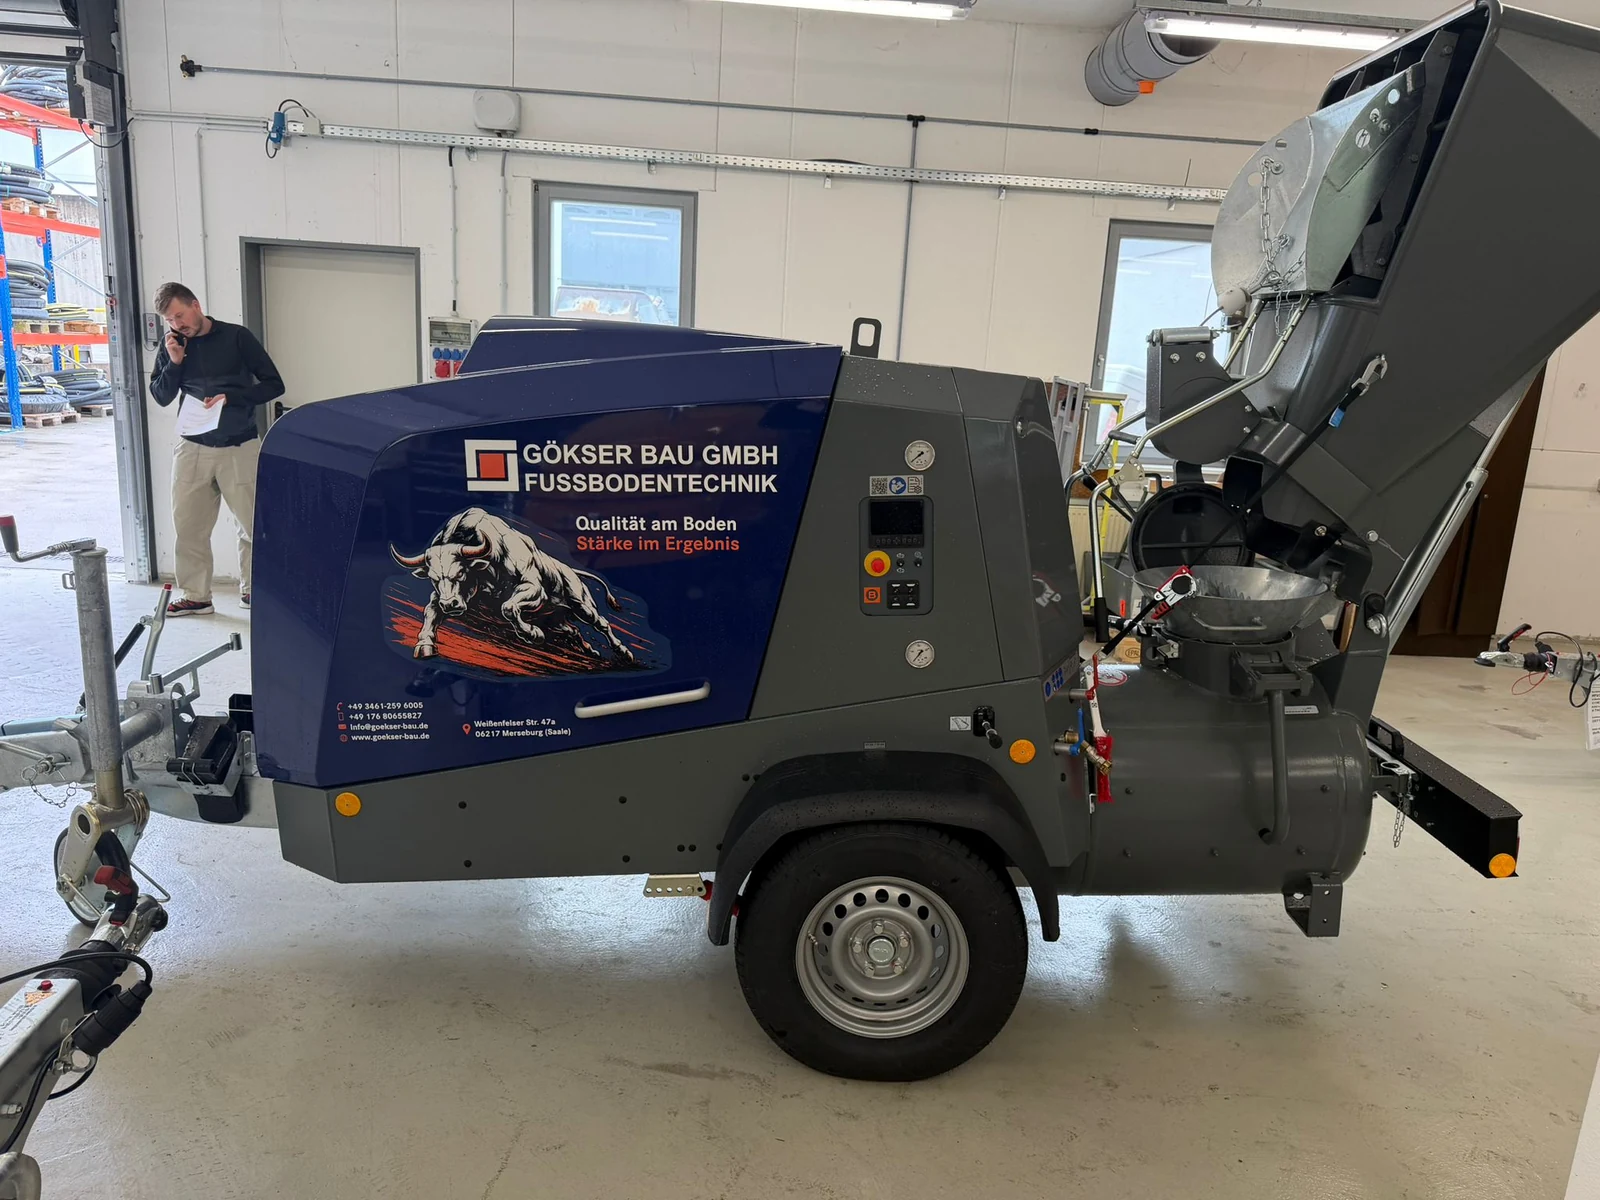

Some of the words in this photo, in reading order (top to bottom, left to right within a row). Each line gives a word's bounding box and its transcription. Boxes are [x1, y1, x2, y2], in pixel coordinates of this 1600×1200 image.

[523, 440, 634, 465] GÖKSER
[641, 444, 694, 465] BAU
[702, 445, 778, 466] GMBH
[525, 473, 778, 494] FUSSBODENTECHNIK
[575, 516, 647, 532] Qualität
[651, 519, 678, 531] am
[683, 517, 738, 531] Boden
[576, 536, 633, 551] Stärke
[638, 536, 660, 551] im
[665, 536, 740, 554] Ergebnis
[365, 702, 402, 710] 3461-259
[382, 712, 423, 720] 80655827
[474, 720, 524, 728] Weißenfelser
[541, 718, 556, 726] 47a
[351, 733, 430, 742] www.goekser-bau.de
[475, 730, 501, 738] 06217
[502, 729, 544, 738] Merseburg
[545, 728, 571, 737] (Saale)
